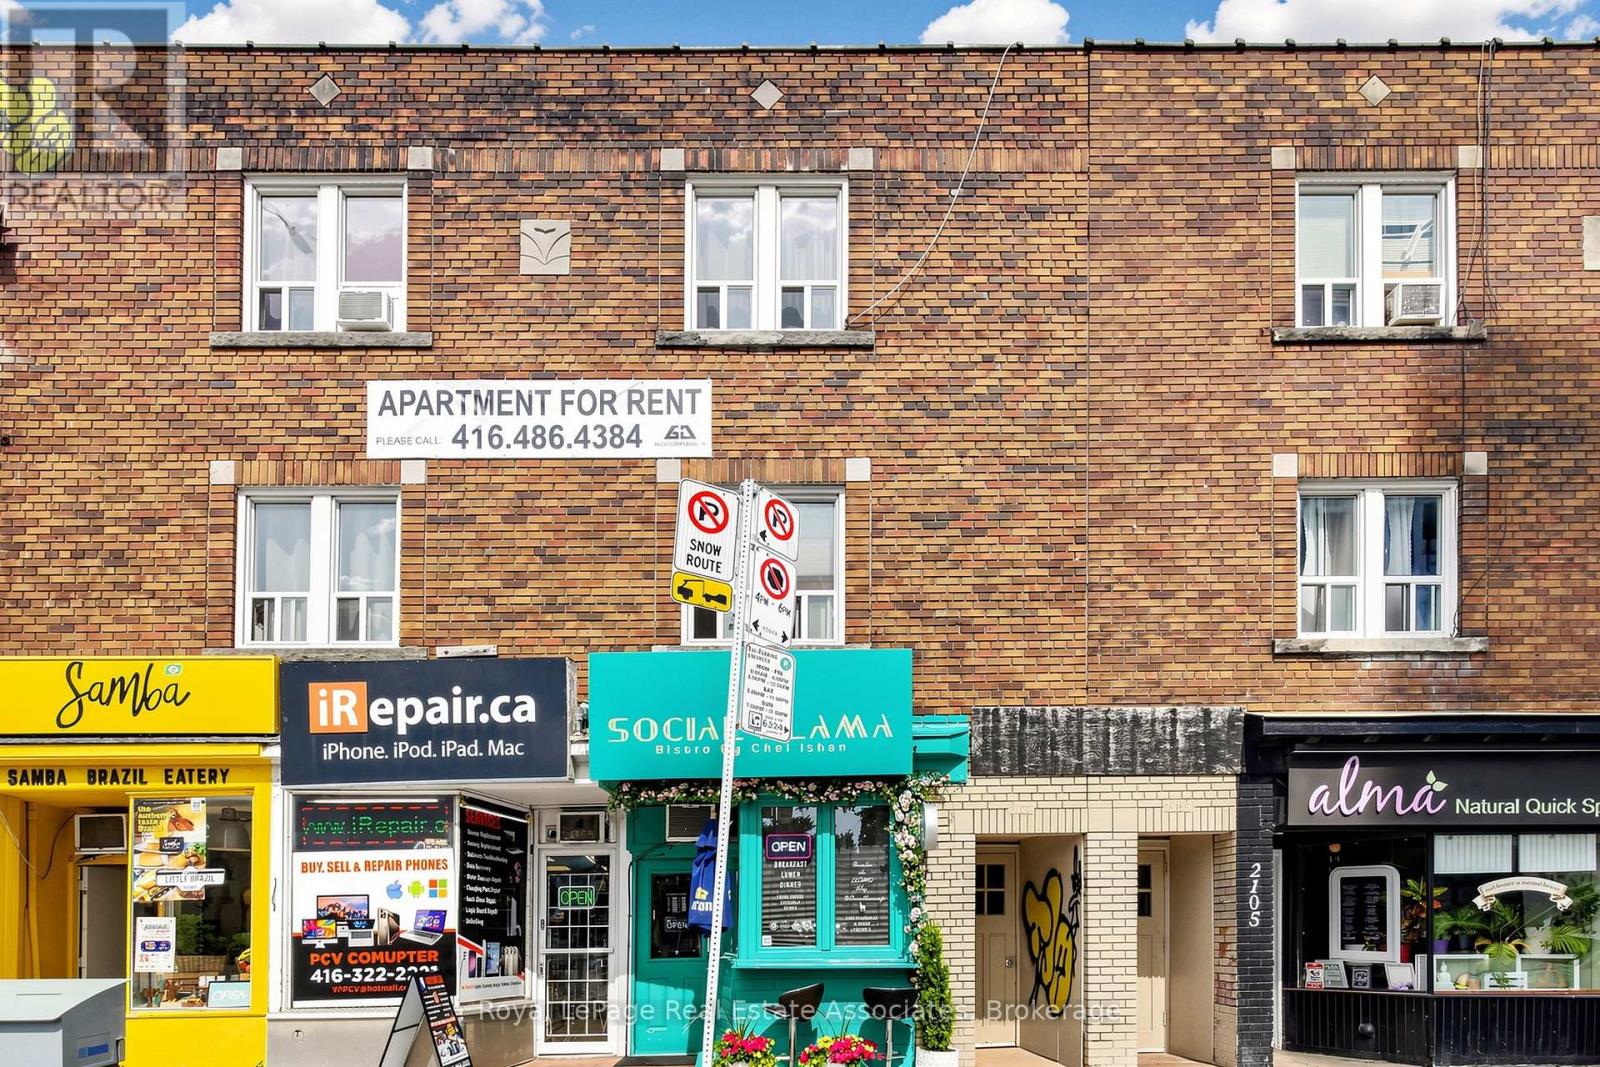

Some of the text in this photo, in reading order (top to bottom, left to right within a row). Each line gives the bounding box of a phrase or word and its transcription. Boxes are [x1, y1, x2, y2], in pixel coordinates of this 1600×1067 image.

[377, 388, 702, 417] APARTMENT FOR RENT
[376, 423, 643, 450] PLEASE CALL 416.486.4384
[689, 538, 722, 557] SNOW
[686, 553, 722, 574] ROUTE
[56, 661, 191, 729] Samba
[318, 686, 537, 736] iRepair.ca
[322, 739, 525, 760] iPhone. iPod. iPad. Mac
[7, 768, 230, 786] SAMBA BRAZIL EATERY
[1308, 755, 1448, 817] alma
[1455, 798, 1520, 814] Natural
[1525, 798, 1577, 814] Quick
[770, 840, 807, 853] OPEN
[327, 860, 351, 873] SELL
[353, 861, 361, 872] &
[364, 859, 402, 872] REPAIR
[405, 858, 449, 871] PHONES
[560, 890, 593, 906] OPEN
[1248, 862, 1262, 928] 2105
[310, 950, 439, 966] PCV COMUPTER
